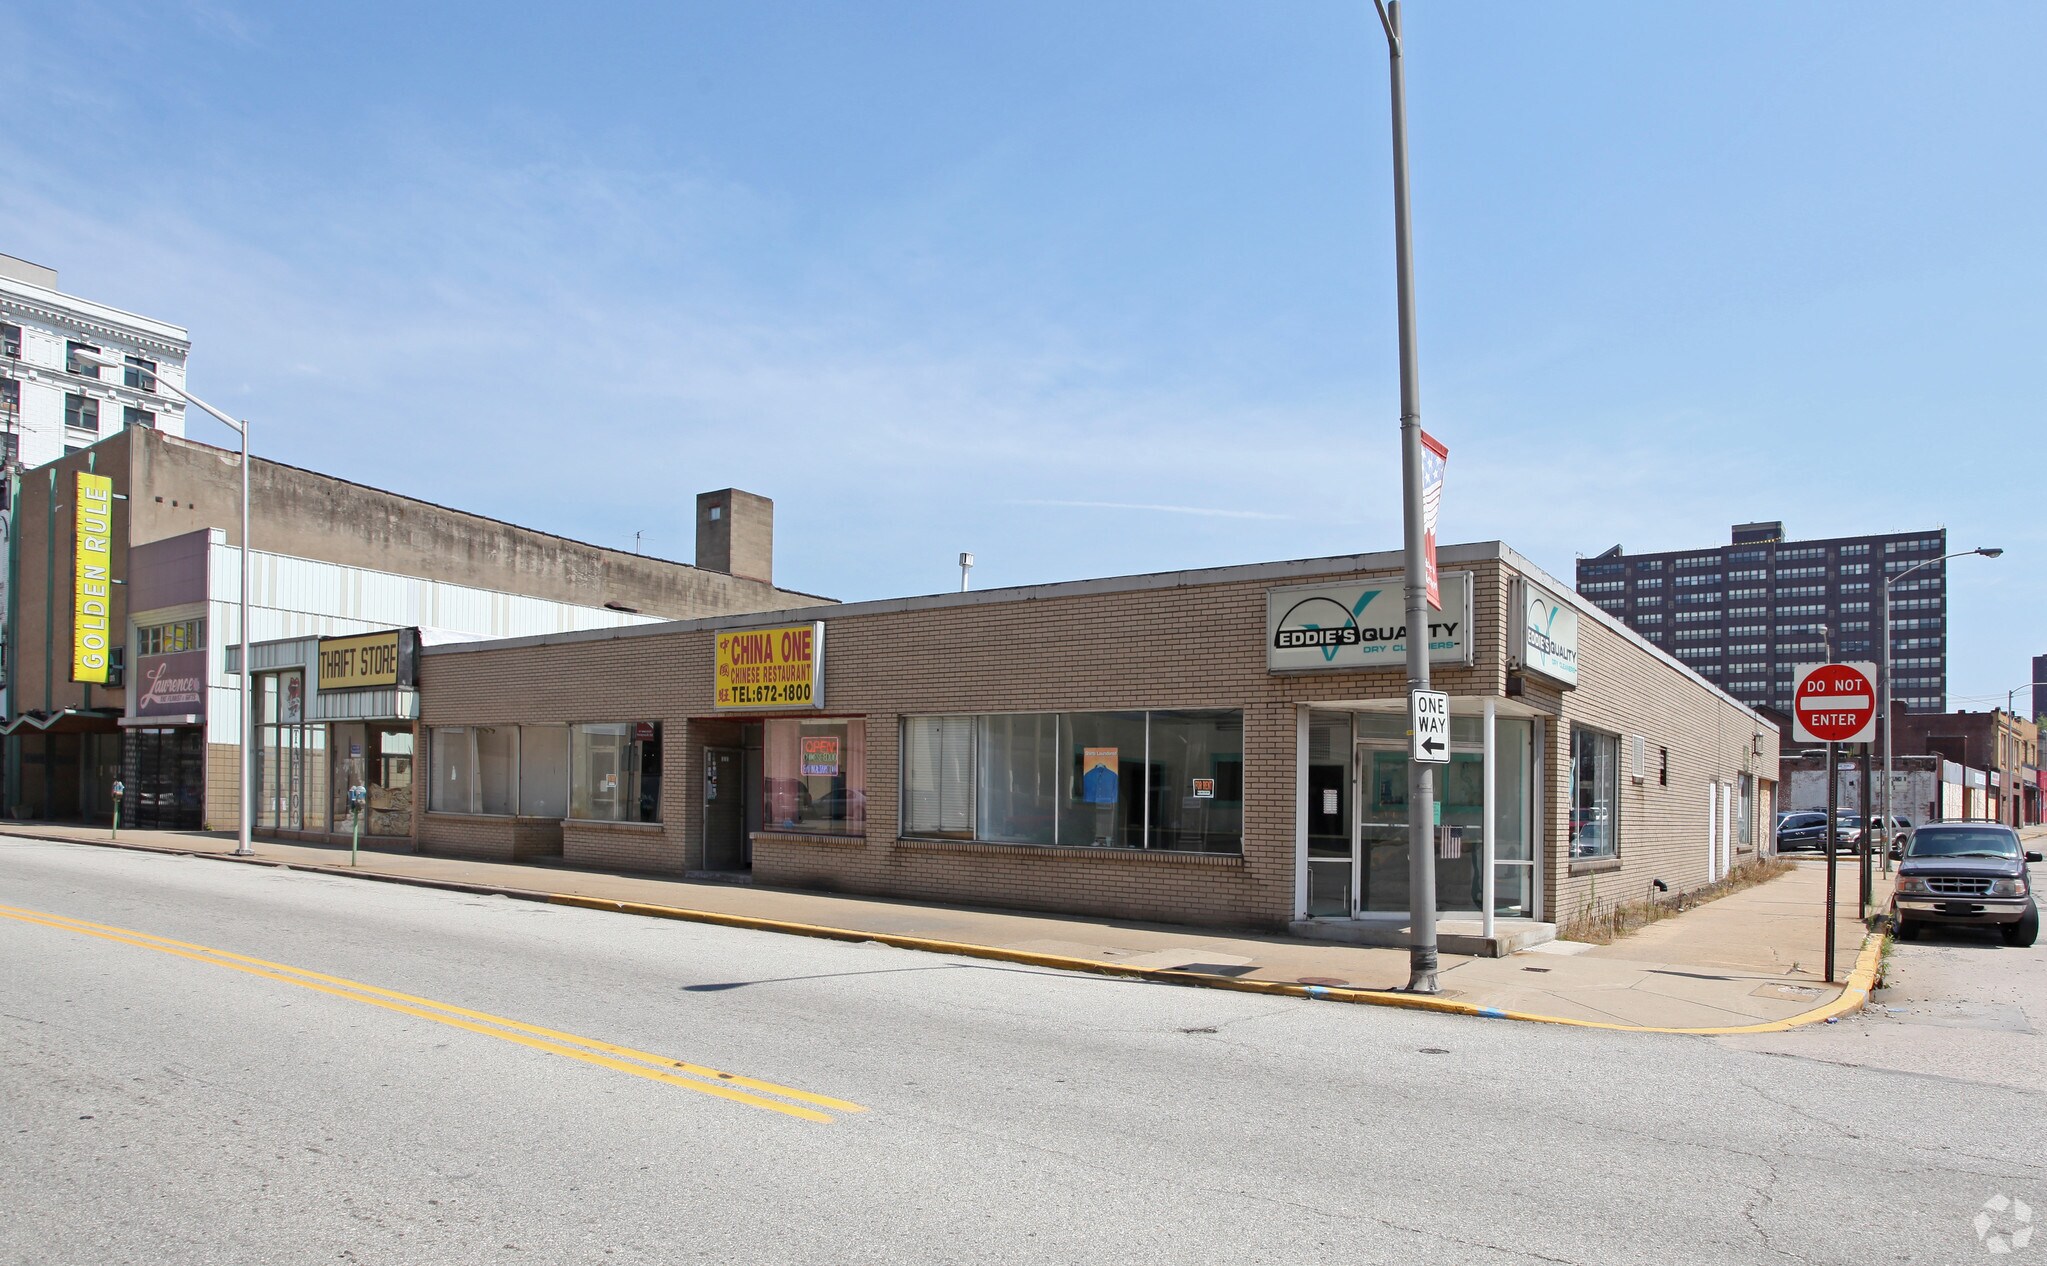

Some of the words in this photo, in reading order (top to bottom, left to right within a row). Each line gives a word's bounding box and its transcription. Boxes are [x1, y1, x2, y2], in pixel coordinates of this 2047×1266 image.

[84, 487, 108, 552] RULE
[81, 565, 106, 669] GOLDEN
[1279, 629, 1355, 646] EDDIE'S
[1362, 622, 1459, 642] QUATY
[731, 634, 773, 666] CHINA
[781, 630, 811, 663] ONE
[1363, 645, 1387, 654] DRY
[1392, 641, 1454, 652] CLERS
[1528, 629, 1550, 653] EDDIE'S
[1550, 640, 1577, 663] QUALITY
[320, 648, 357, 680] THRIFT
[360, 643, 397, 676] STORE
[731, 667, 760, 684] CHINESE
[763, 664, 811, 683] RESTAURANT
[732, 683, 811, 703] TEL:672-1800
[1807, 680, 1826, 692] DO
[1835, 679, 1863, 691] NOT
[1418, 696, 1445, 714] ONE
[1419, 716, 1446, 733] WAY
[1811, 714, 1856, 726] ENTER
[805, 740, 836, 753] OPEN
[292, 729, 300, 825] TATTOO
